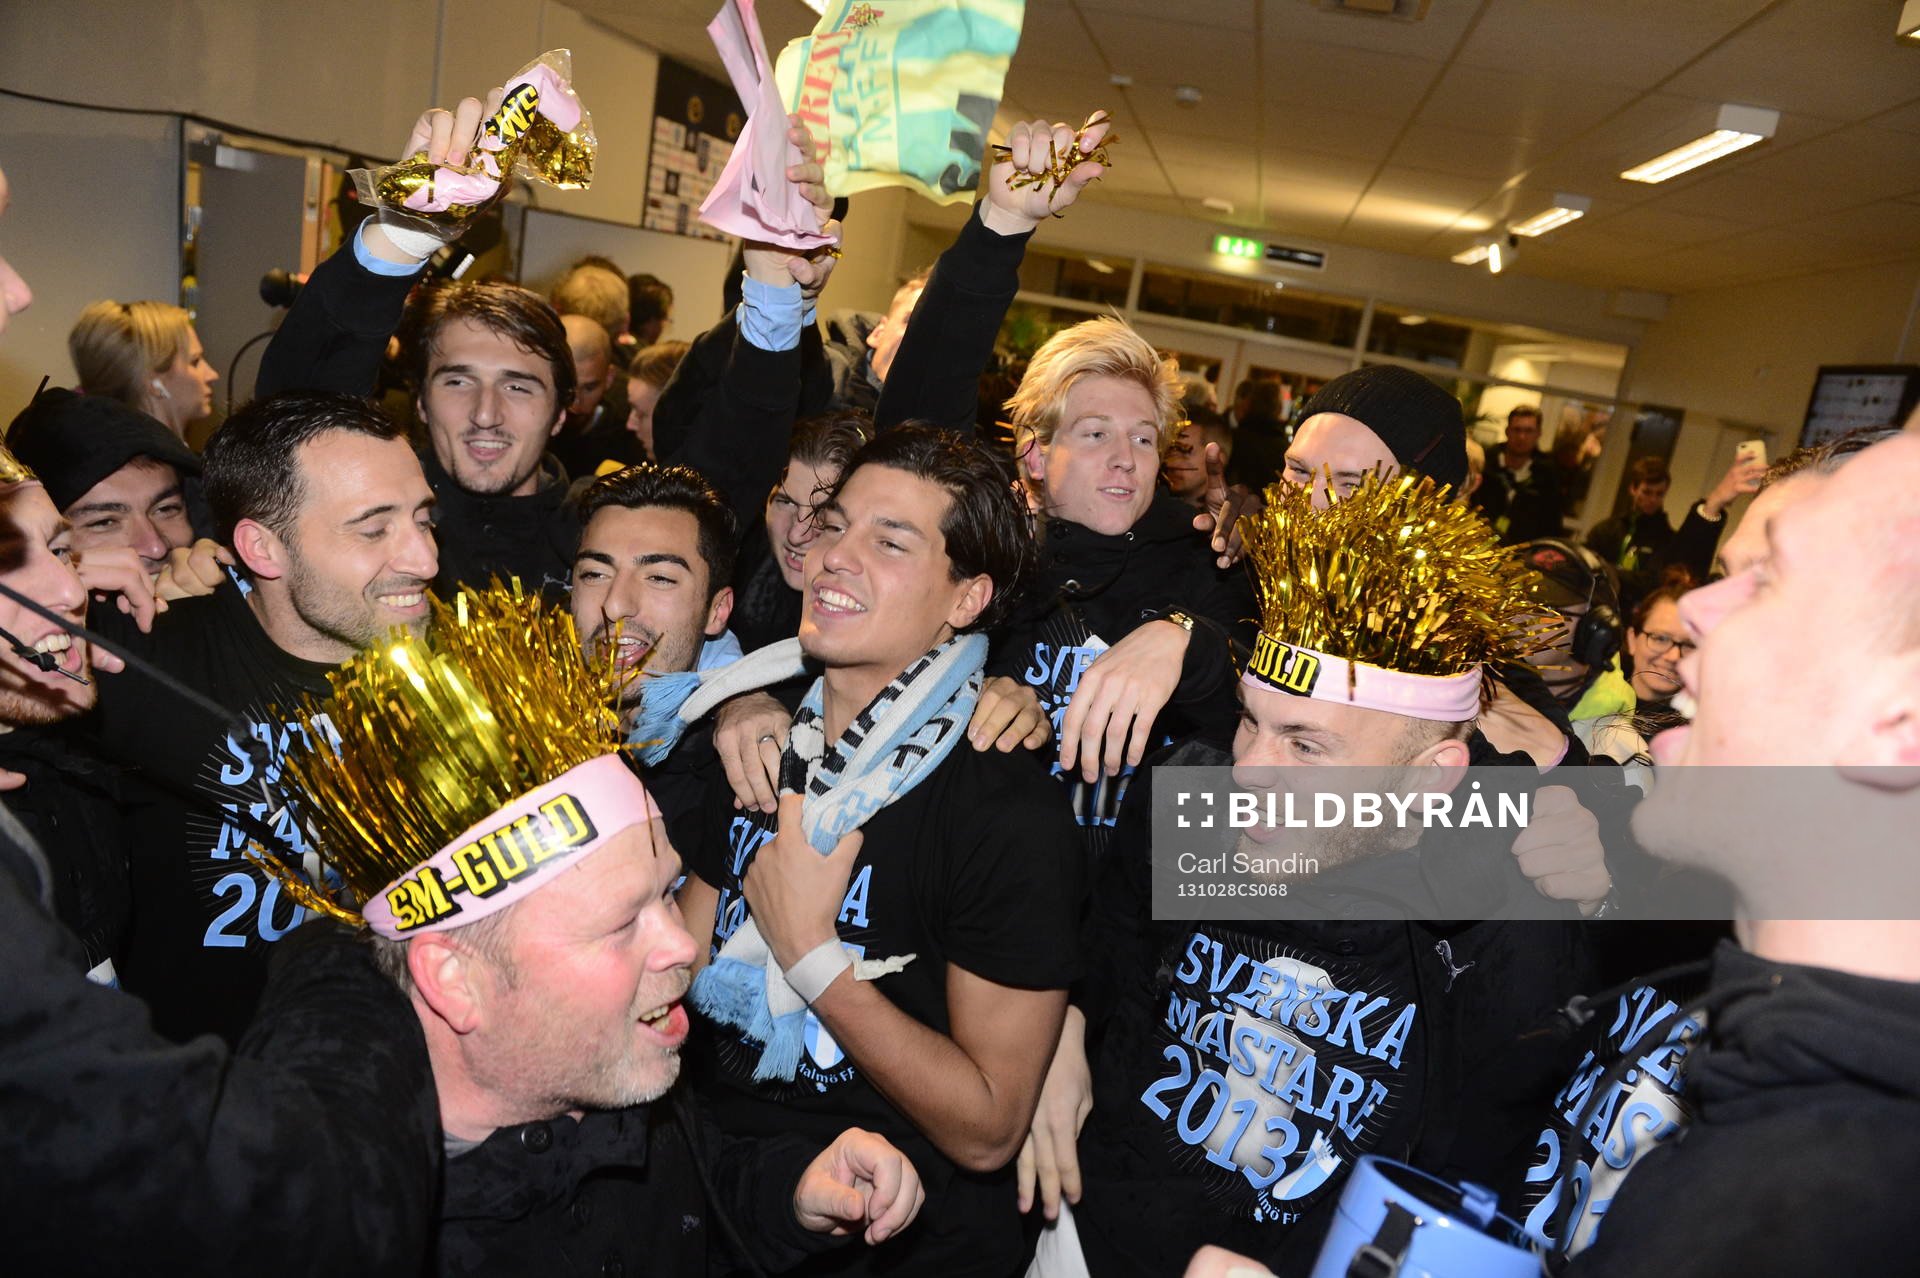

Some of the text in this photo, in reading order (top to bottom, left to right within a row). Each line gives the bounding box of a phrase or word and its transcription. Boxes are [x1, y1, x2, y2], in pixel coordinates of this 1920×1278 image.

[386, 793, 597, 931] SM-GULD
[1164, 991, 1389, 1142] MÄSTARE
[1174, 932, 1417, 1069] SVENSKA
[1140, 1044, 1301, 1190] 2013
